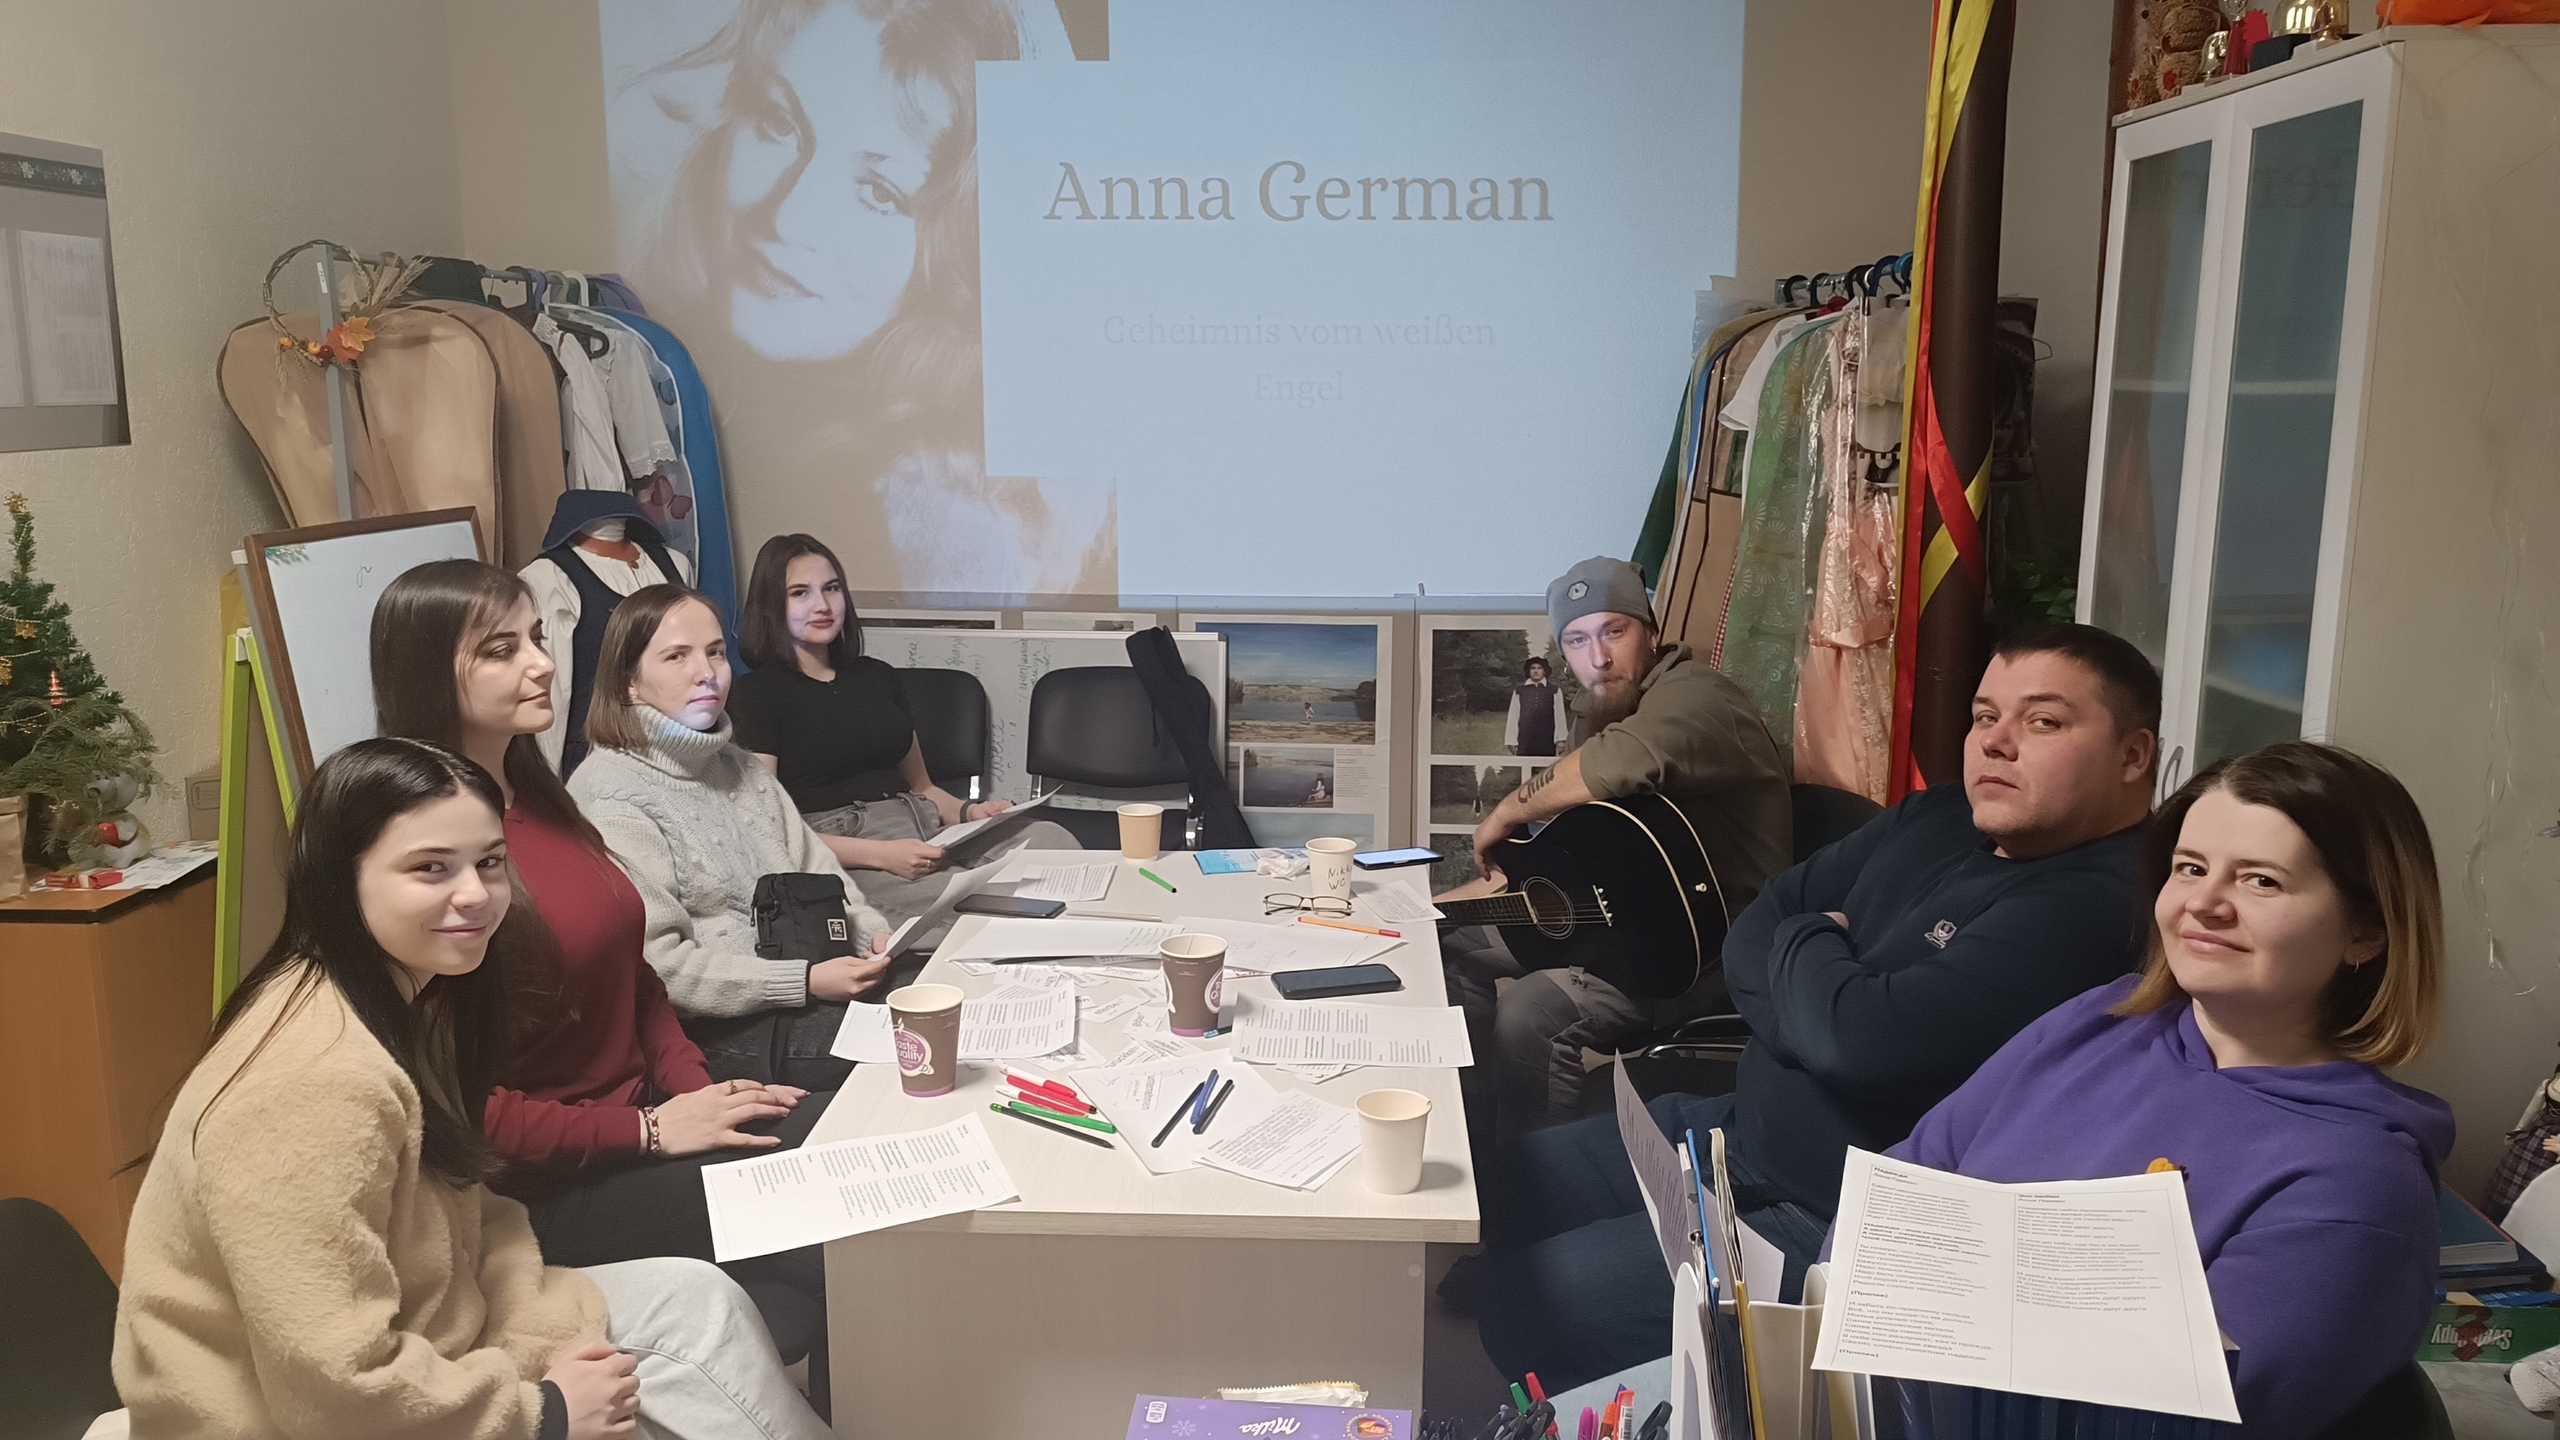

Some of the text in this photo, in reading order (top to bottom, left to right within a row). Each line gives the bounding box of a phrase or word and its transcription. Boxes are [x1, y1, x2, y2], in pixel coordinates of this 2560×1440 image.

[1043, 159, 1554, 223] Anna German
[1102, 314, 1498, 347] Geheimnis vom weißen
[1253, 372, 1347, 410] Engel
[896, 1040, 918, 1052] aste
[897, 1048, 924, 1063] uality
[1239, 1416, 1302, 1437] Milka
